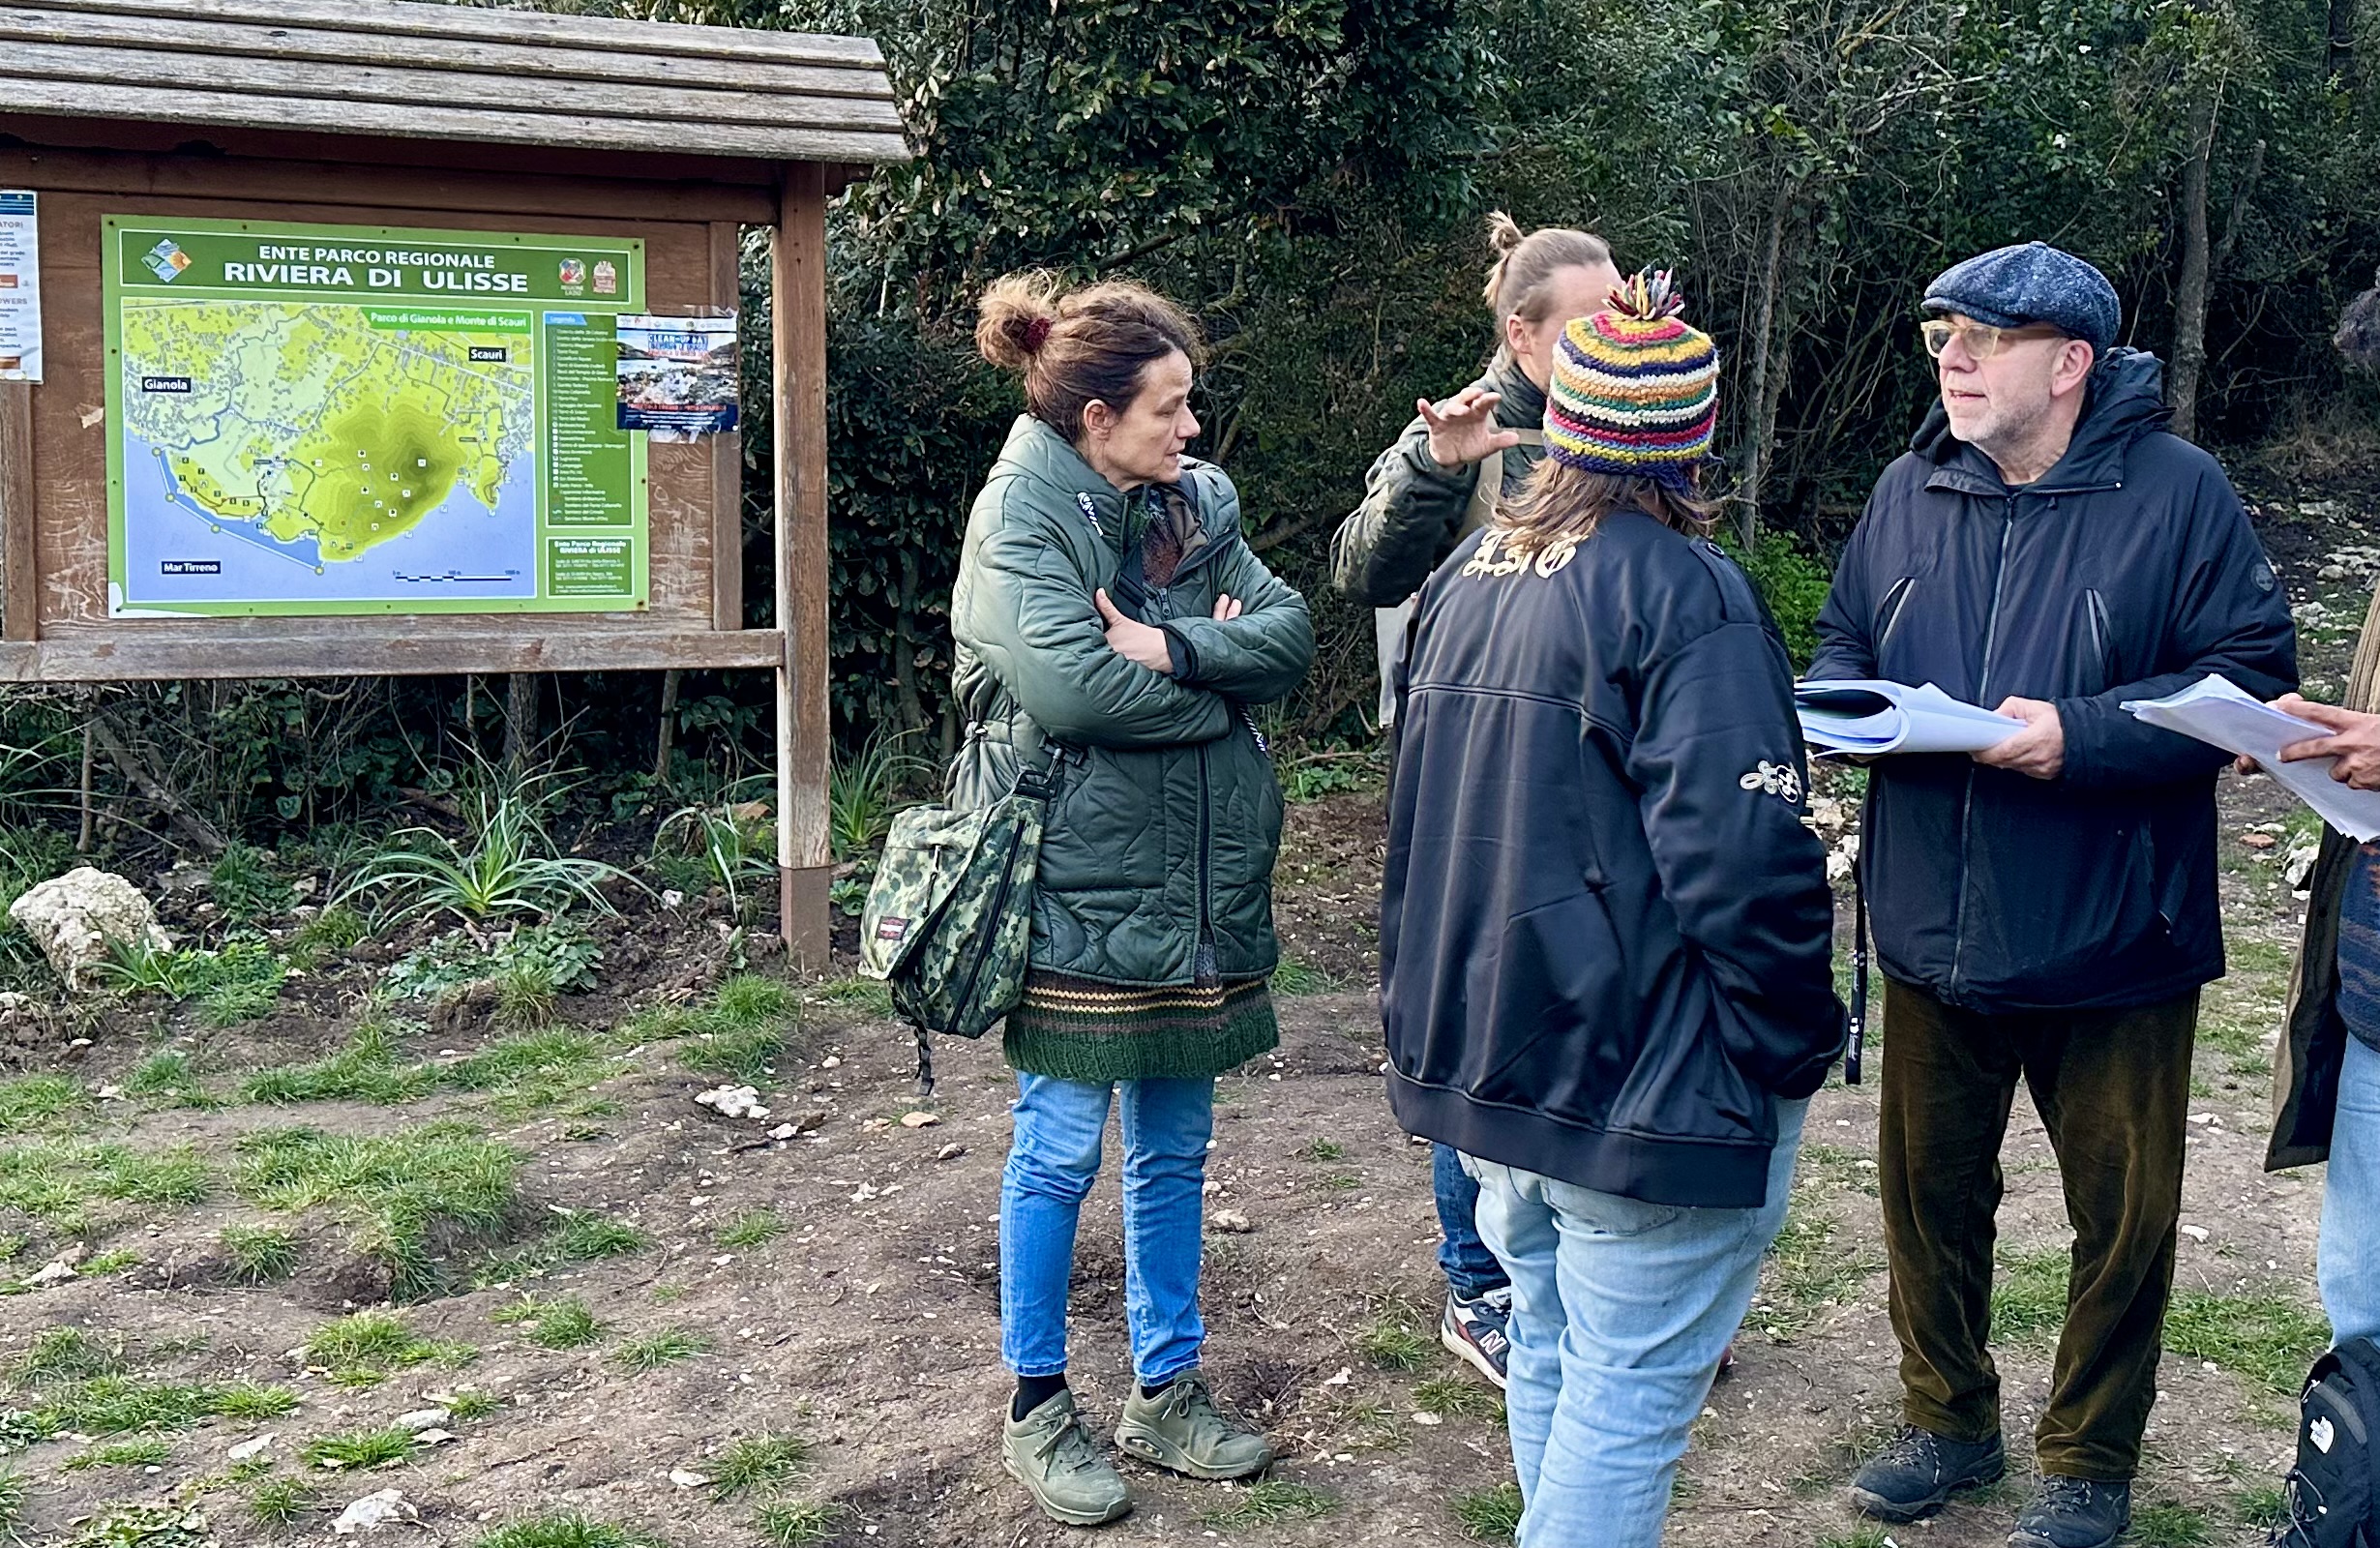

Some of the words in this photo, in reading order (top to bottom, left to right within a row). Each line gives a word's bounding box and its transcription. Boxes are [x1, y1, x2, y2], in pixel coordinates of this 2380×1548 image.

[259, 246, 310, 261] ENTE
[314, 248, 381, 264] PARCO
[385, 251, 495, 269] REGIONALE
[224, 263, 354, 285] RIVIERA
[368, 268, 402, 287] DI
[423, 270, 528, 292] ULISSE
[371, 313, 397, 323] Parco
[399, 313, 408, 323] di
[409, 313, 446, 325] Gianola
[447, 316, 454, 325] e
[456, 315, 486, 326] Monte
[488, 315, 496, 326] di
[498, 316, 526, 327] Scauri
[470, 348, 503, 360] Scauri
[144, 378, 188, 390] Gianola
[164, 562, 182, 572] Mar
[184, 562, 218, 572] Tirreno
[1479, 1328, 1507, 1355] N
